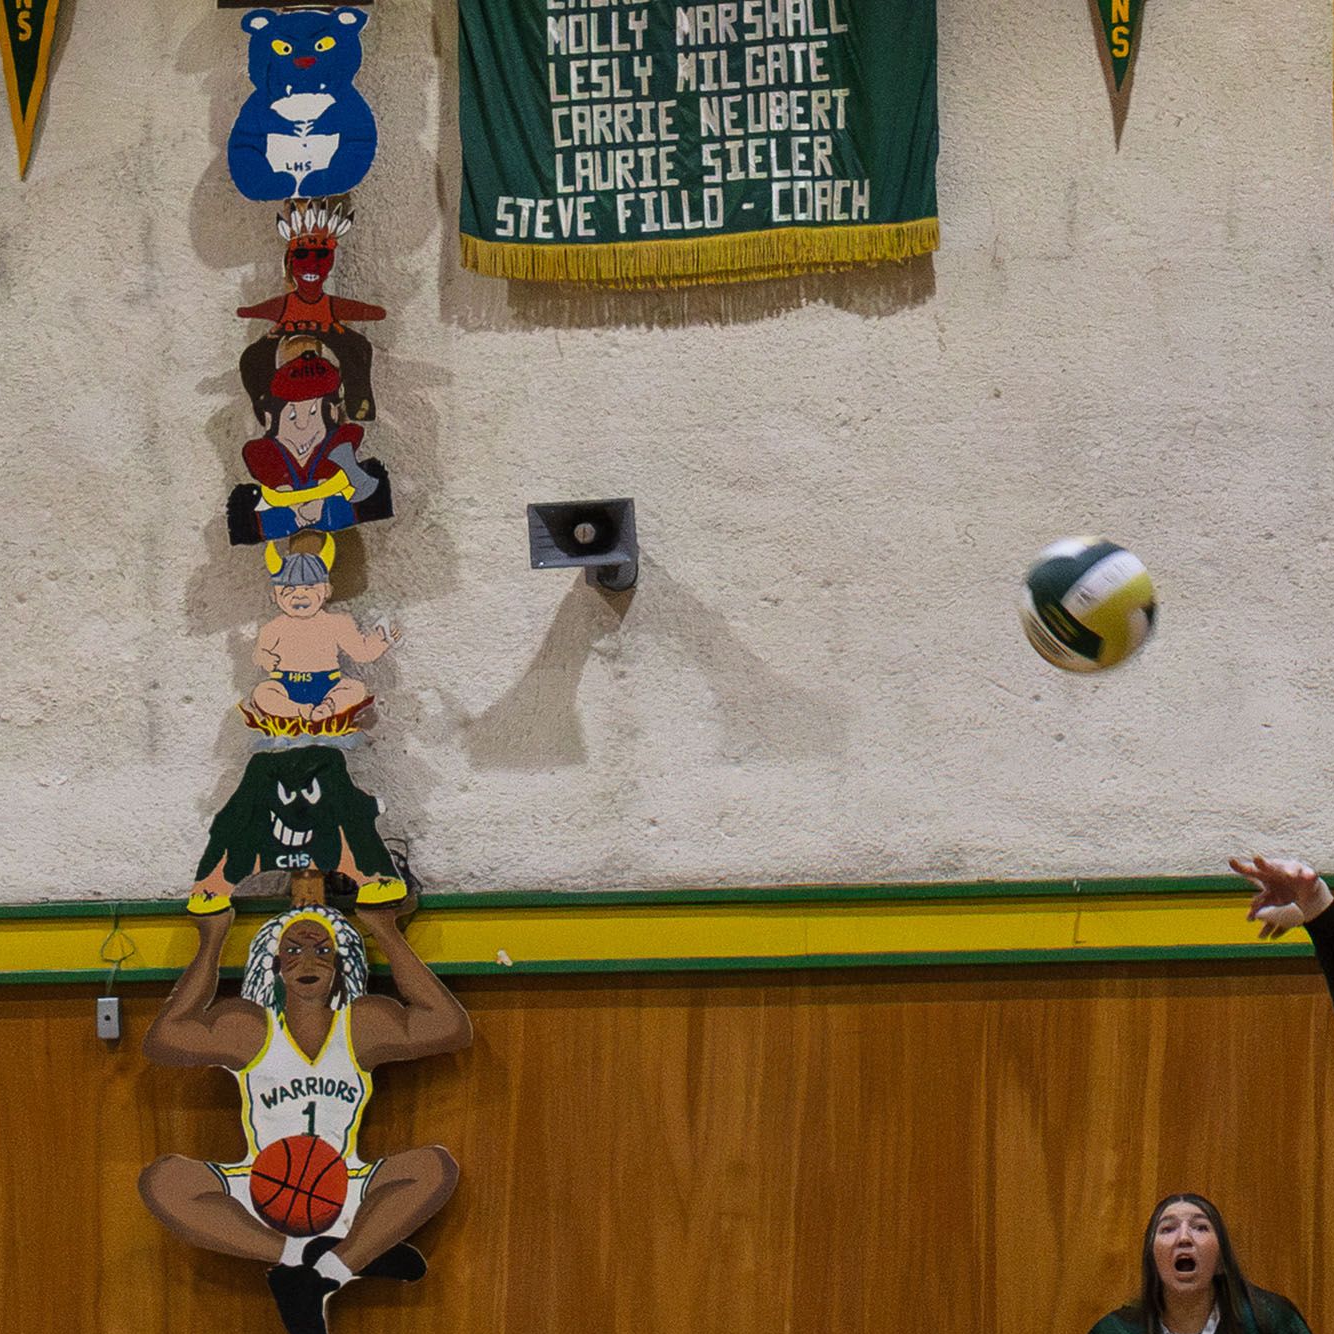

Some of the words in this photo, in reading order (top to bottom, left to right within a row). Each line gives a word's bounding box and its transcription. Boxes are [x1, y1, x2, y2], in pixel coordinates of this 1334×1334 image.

[548, 10, 648, 55] MOLLY
[676, 0, 848, 45] MARSHALL
[549, 56, 652, 102] LESLY
[677, 40, 830, 92] MILGATE
[552, 100, 679, 147] CARRIE
[700, 88, 850, 137] NEUBERT
[286, 162, 312, 171] LHS
[556, 146, 679, 193] LAURIE
[702, 135, 833, 183] SIELER
[495, 196, 596, 239] STEVE
[617, 187, 723, 234] FILLO
[771, 179, 870, 222] COACH
[289, 672, 313, 682] HHS
[275, 853, 310, 868] CHS
[260, 1076, 358, 1109] WARRIORS
[302, 1101, 319, 1137] 1
